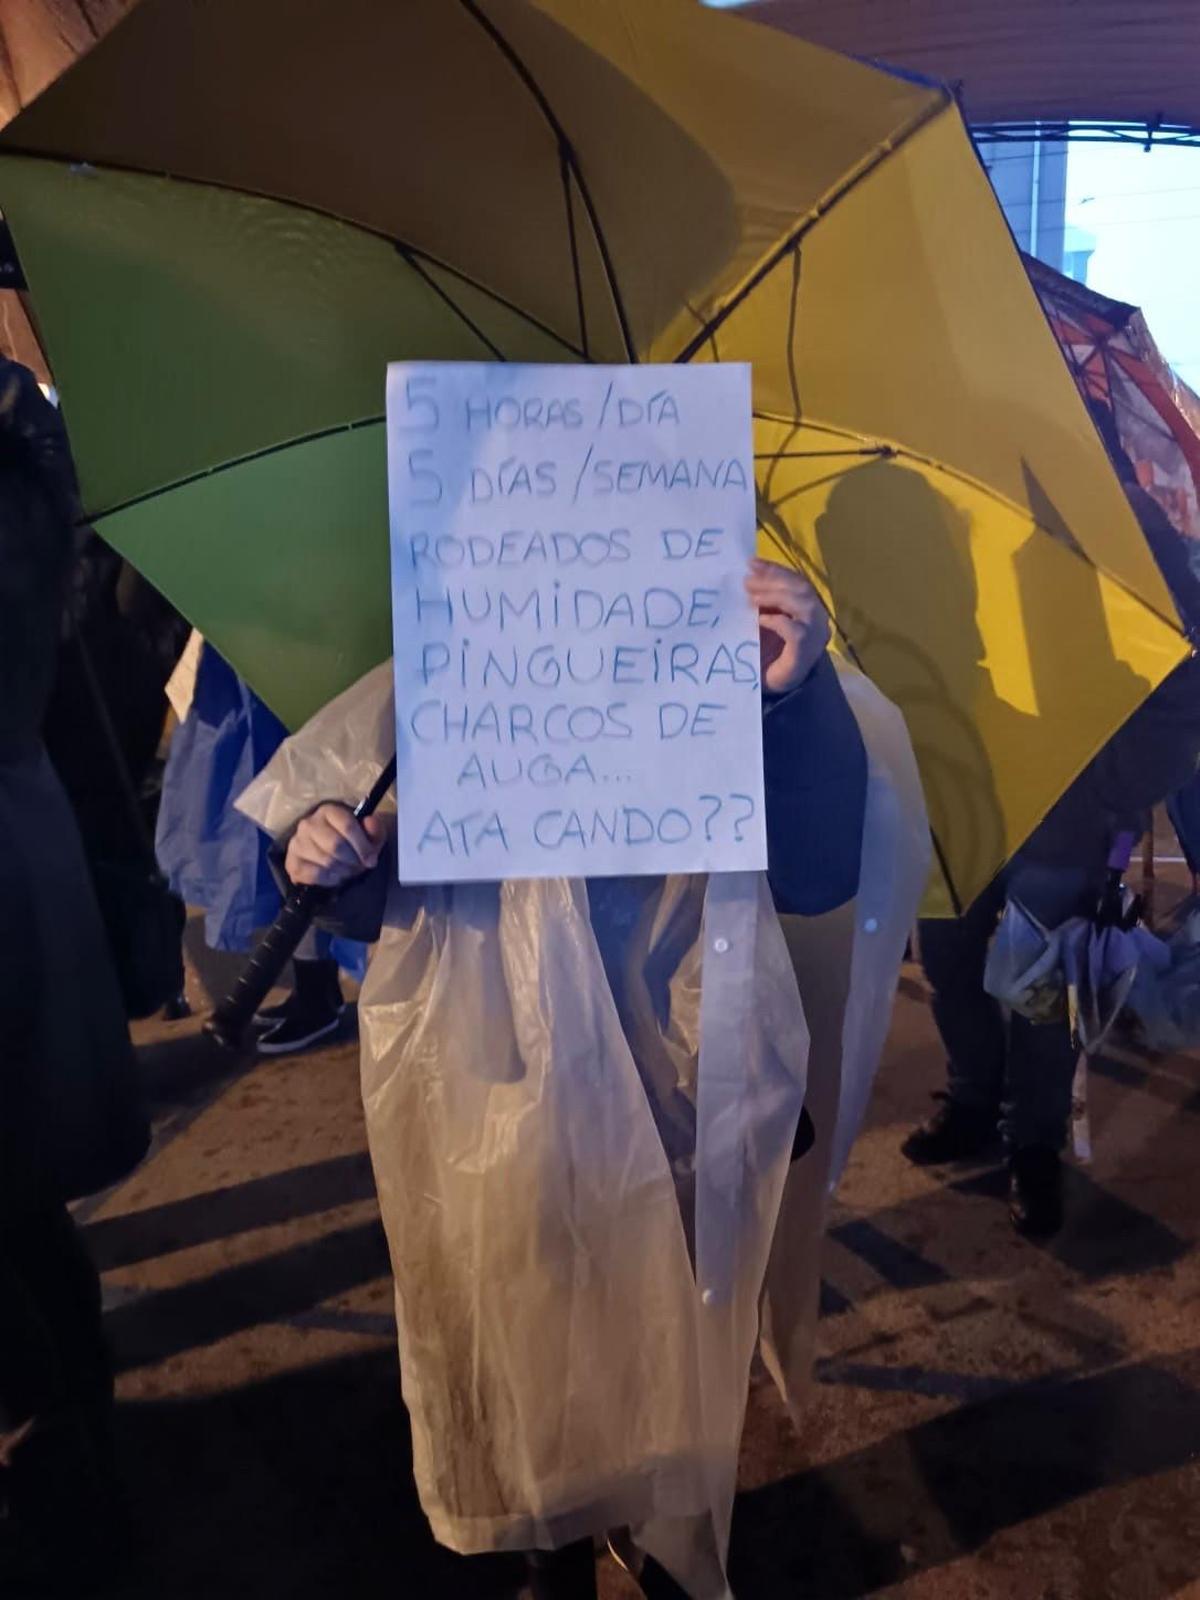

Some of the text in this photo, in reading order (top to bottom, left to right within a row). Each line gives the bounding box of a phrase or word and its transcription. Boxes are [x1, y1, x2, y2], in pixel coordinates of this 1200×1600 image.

[404, 377, 440, 431] 5
[407, 449, 443, 508] 5
[408, 528, 725, 572] RODEADOS DE
[410, 699, 727, 746] CHARCOS DE
[456, 752, 633, 789] AUGA...
